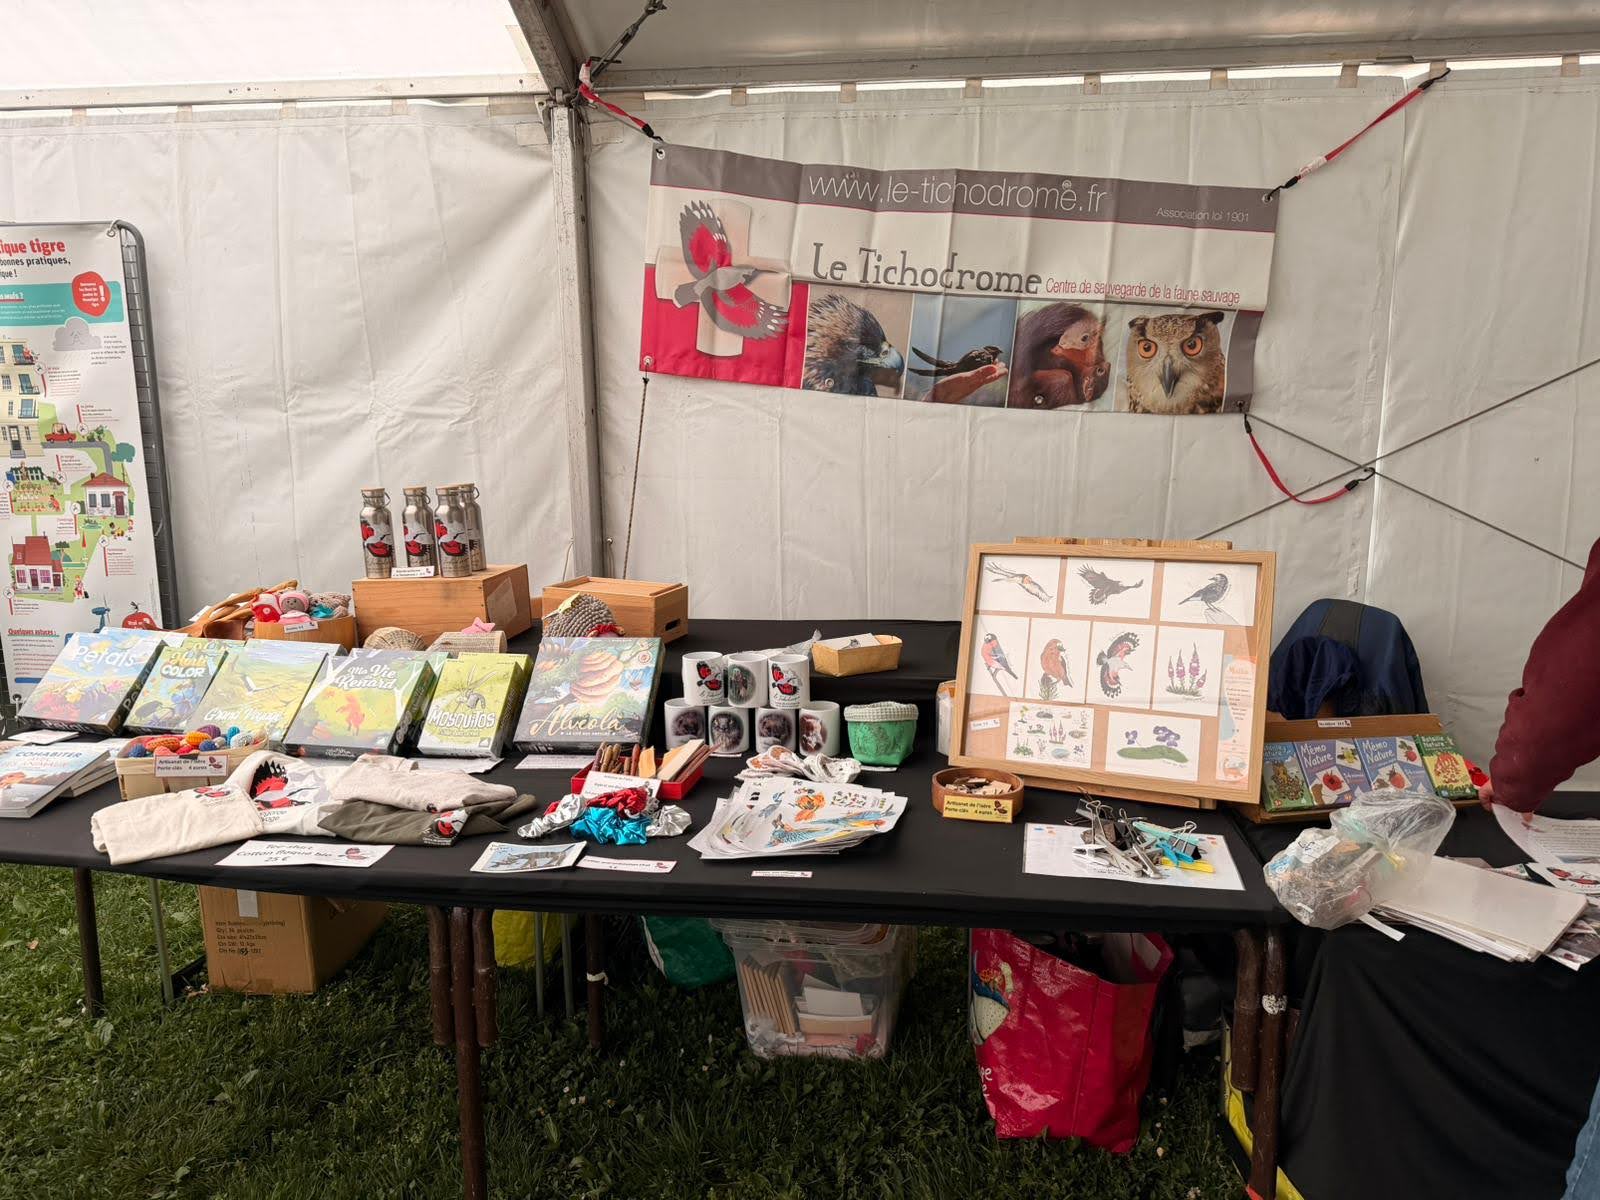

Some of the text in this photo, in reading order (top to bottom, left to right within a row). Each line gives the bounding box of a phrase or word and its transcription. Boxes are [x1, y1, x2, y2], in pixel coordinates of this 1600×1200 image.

[809, 175, 1107, 212] www.le-tichodrome.fr
[1156, 207, 1249, 222] Association loi 1901
[0, 238, 66, 257] ique tigre
[26, 256, 71, 267] pratiques,
[812, 242, 1043, 295] Le Tichodrome
[1045, 278, 1241, 306] Centre de sauvegarde de la faune sauvage
[71, 645, 137, 667] Petals
[161, 665, 206, 677] COLOR
[347, 664, 397, 679] Ma Vie
[336, 675, 398, 690] Renard
[1300, 743, 1327, 757] Mémo
[1362, 740, 1388, 753] Mémo
[1304, 752, 1334, 768] Nature
[1367, 750, 1393, 764] Nature
